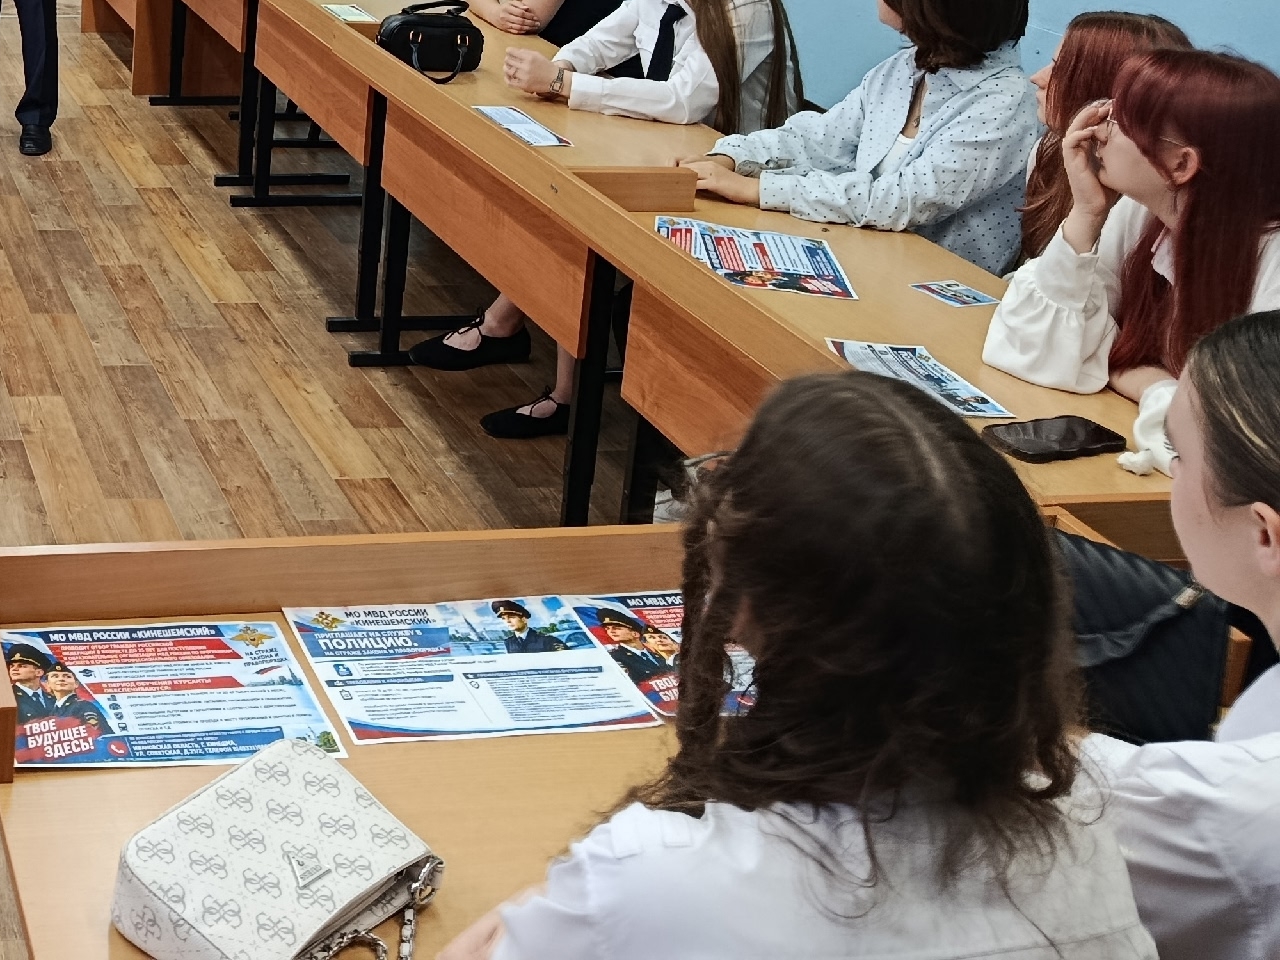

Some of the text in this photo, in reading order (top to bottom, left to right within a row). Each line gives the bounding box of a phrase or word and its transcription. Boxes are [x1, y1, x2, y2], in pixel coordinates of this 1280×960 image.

[344, 608, 429, 619] МО МВД РОССИИ
[351, 616, 437, 626] «КИНЕШЕМСКИЙ»
[49, 626, 216, 642] МО МВД РОССИИ «КИНЕШЕМСКИЙ»
[318, 636, 419, 650] ПОЛИЦИЮ.
[24, 719, 56, 735] ТВОЕ
[28, 726, 88, 748] БУДУЩЕЕ
[44, 737, 94, 758] ЗДЕСЬ!
